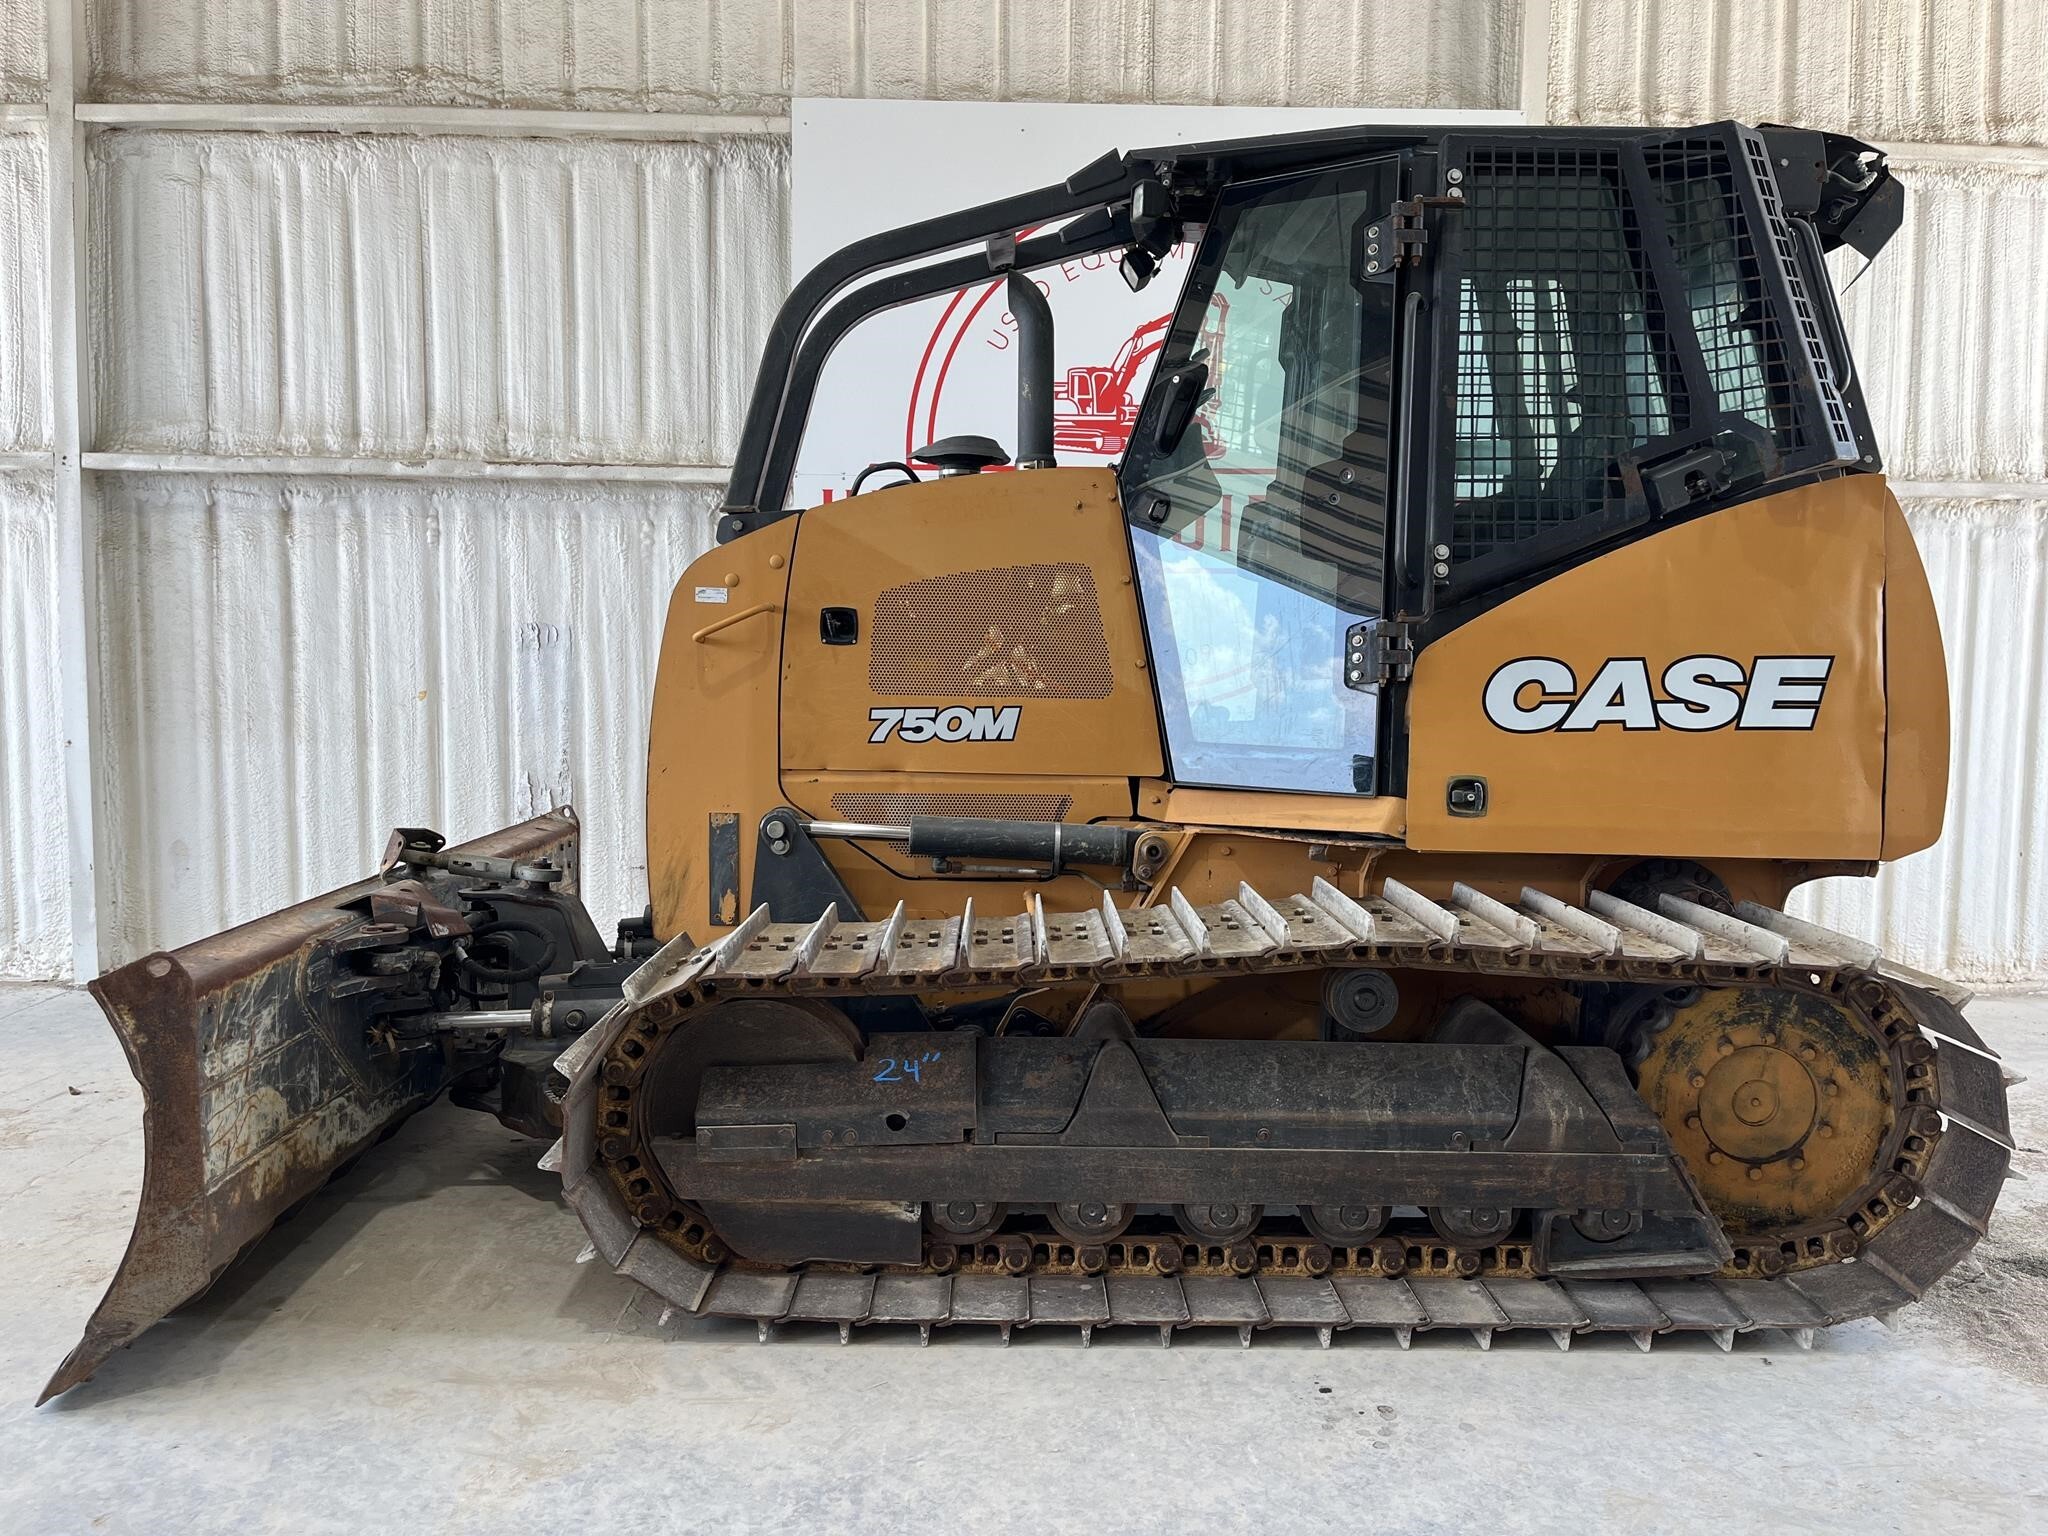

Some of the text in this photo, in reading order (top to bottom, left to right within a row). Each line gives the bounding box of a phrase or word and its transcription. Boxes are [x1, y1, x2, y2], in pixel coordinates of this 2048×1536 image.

[1482, 654, 1835, 734] CASE
[868, 705, 1022, 743] 750M
[873, 1051, 941, 1082] 24"
